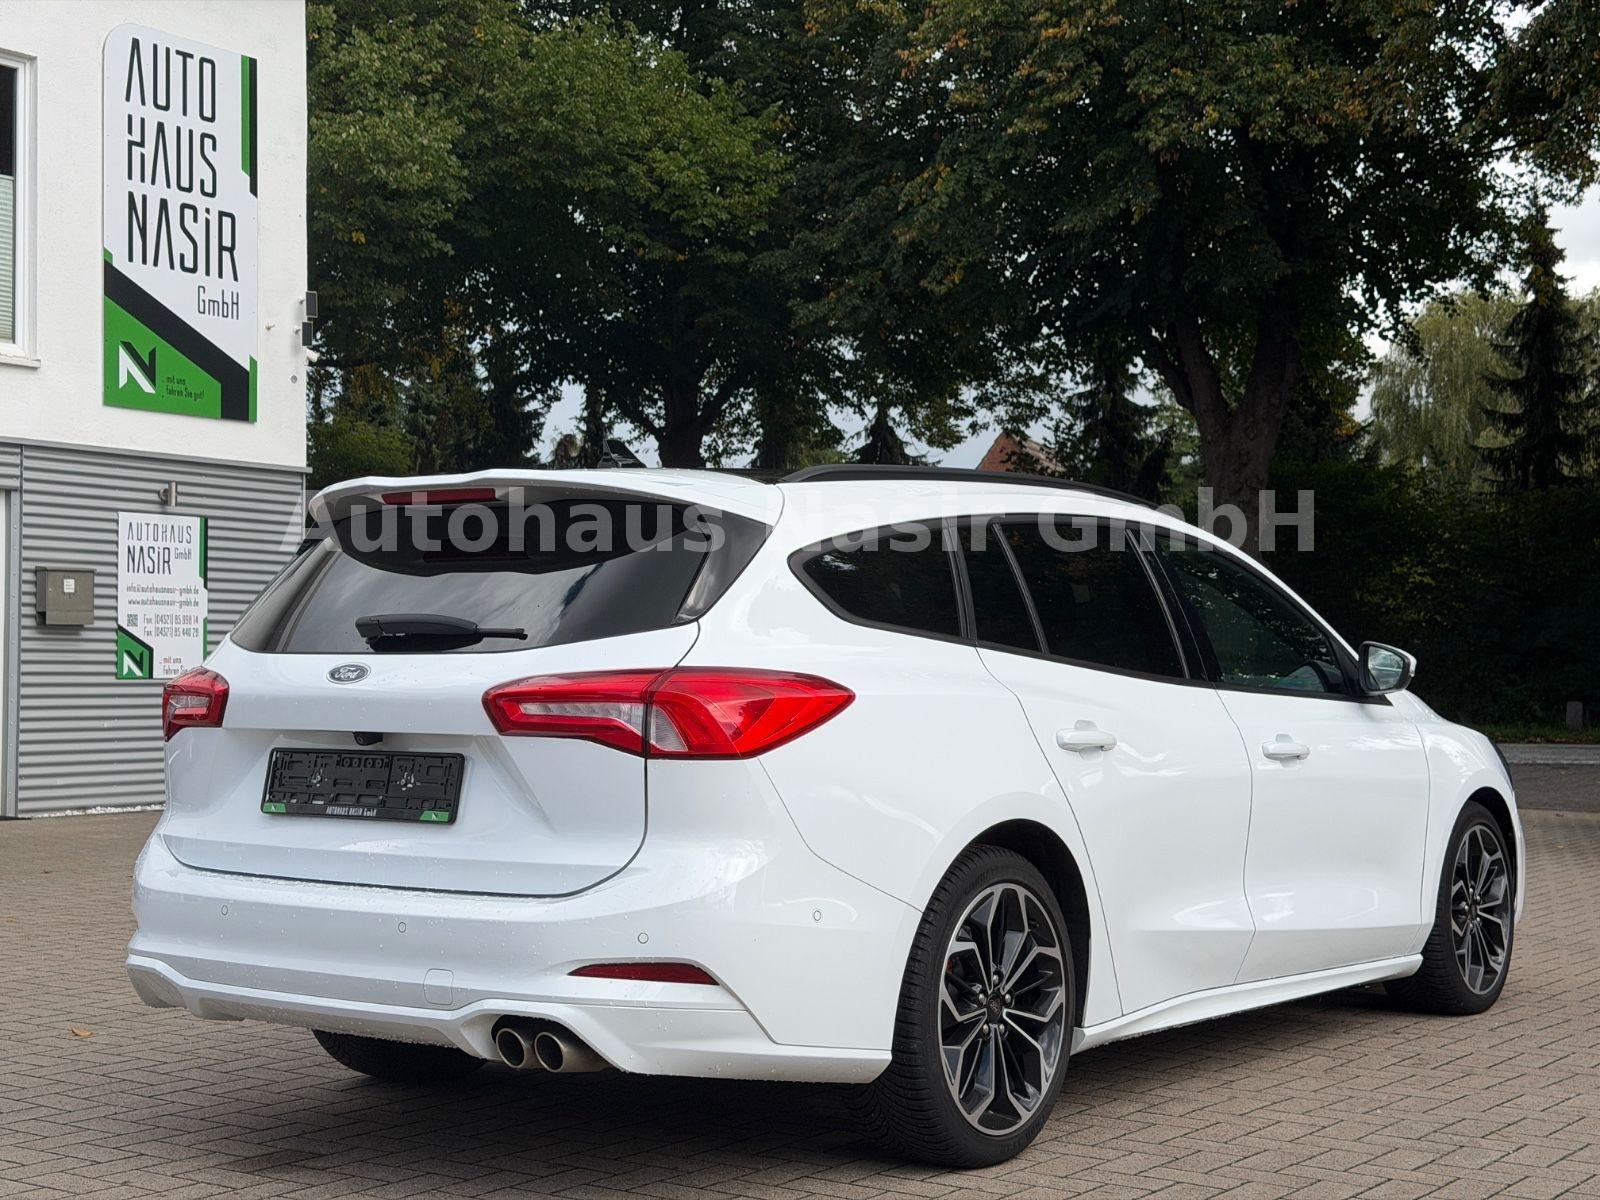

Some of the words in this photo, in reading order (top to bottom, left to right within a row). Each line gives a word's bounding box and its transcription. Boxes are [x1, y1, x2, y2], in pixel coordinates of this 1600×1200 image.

[125, 37, 217, 123] AUTO
[127, 114, 217, 198] HAUS
[197, 285, 240, 320] GmbH
[127, 521, 192, 544] AUTOHAUS
[174, 547, 192, 561] GmbH
